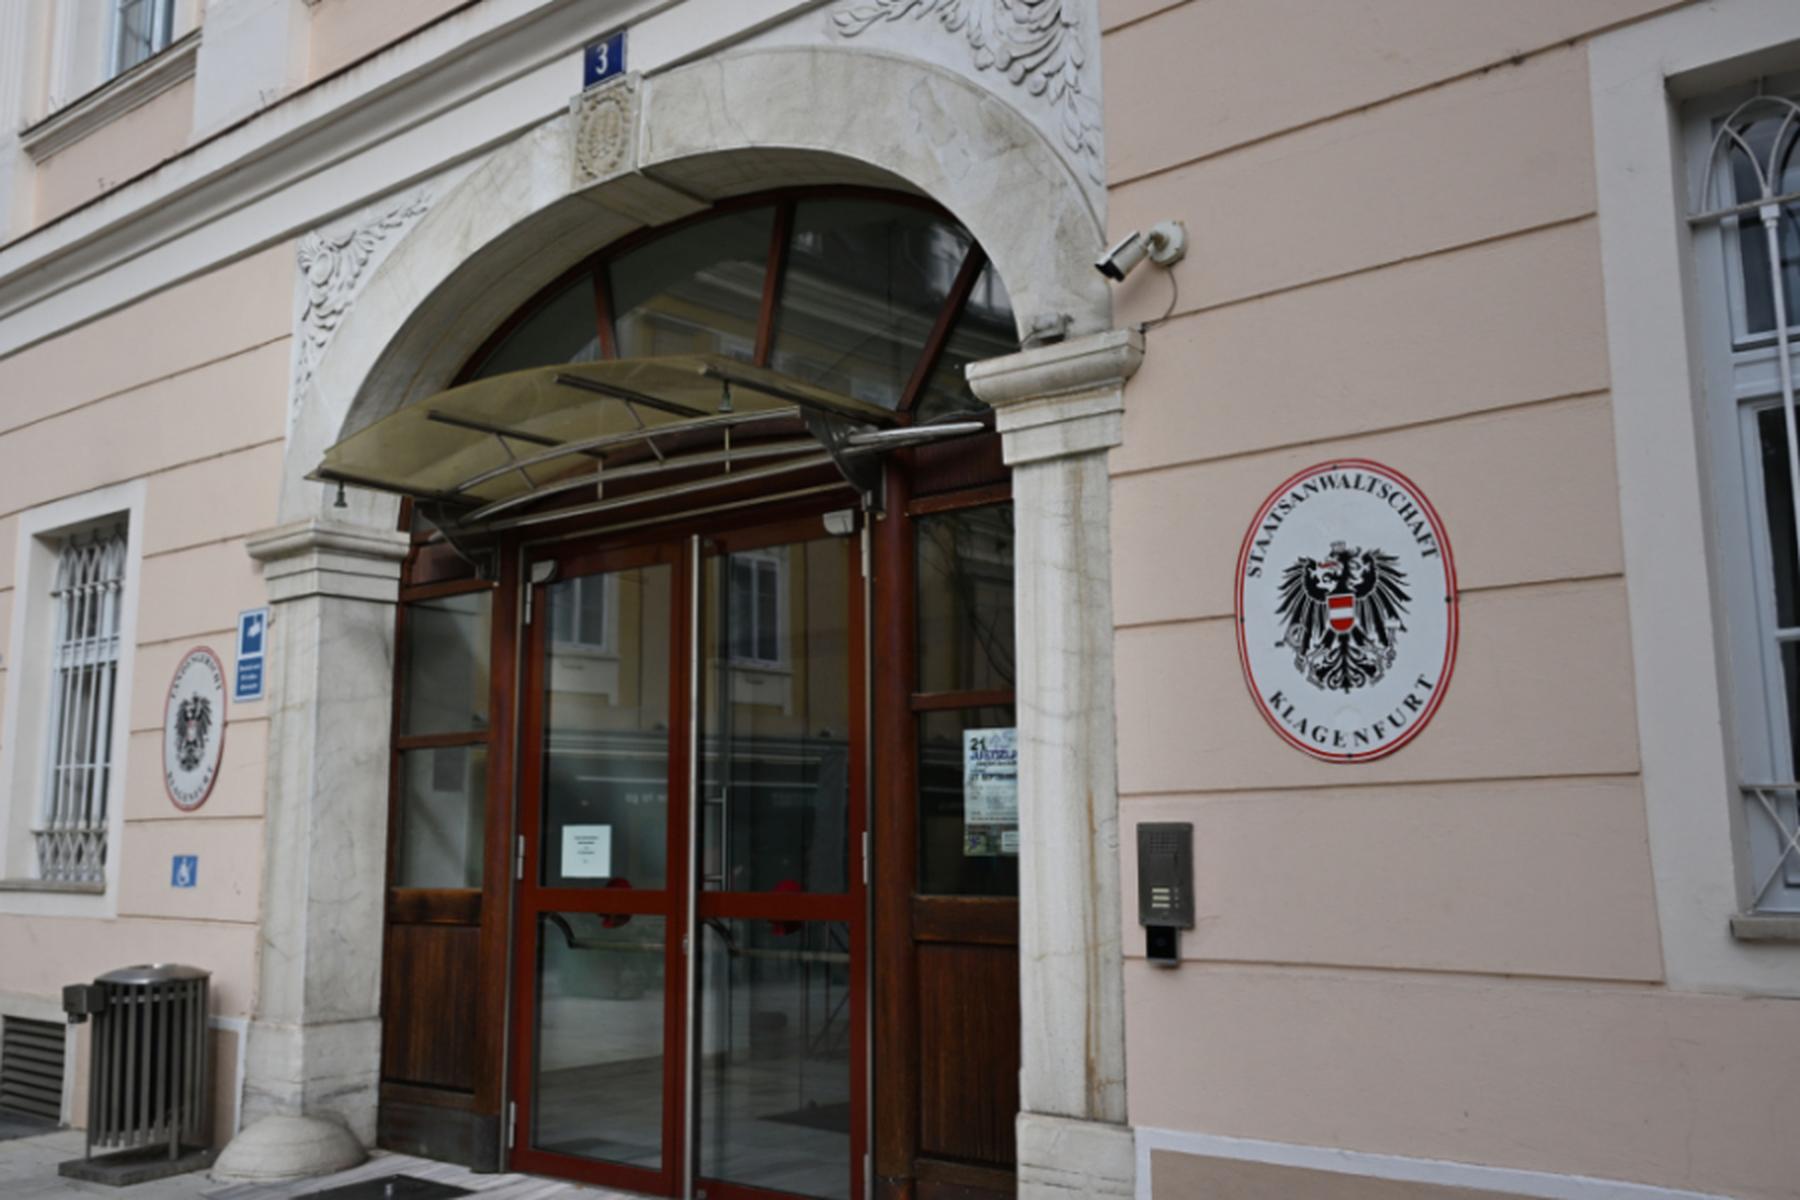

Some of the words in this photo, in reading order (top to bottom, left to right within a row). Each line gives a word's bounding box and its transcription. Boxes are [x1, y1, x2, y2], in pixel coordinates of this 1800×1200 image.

[595, 42, 608, 75] 3
[1247, 473, 1440, 578] STAATSANWALTSCHAFT
[1268, 673, 1434, 748] KLAGENFURT
